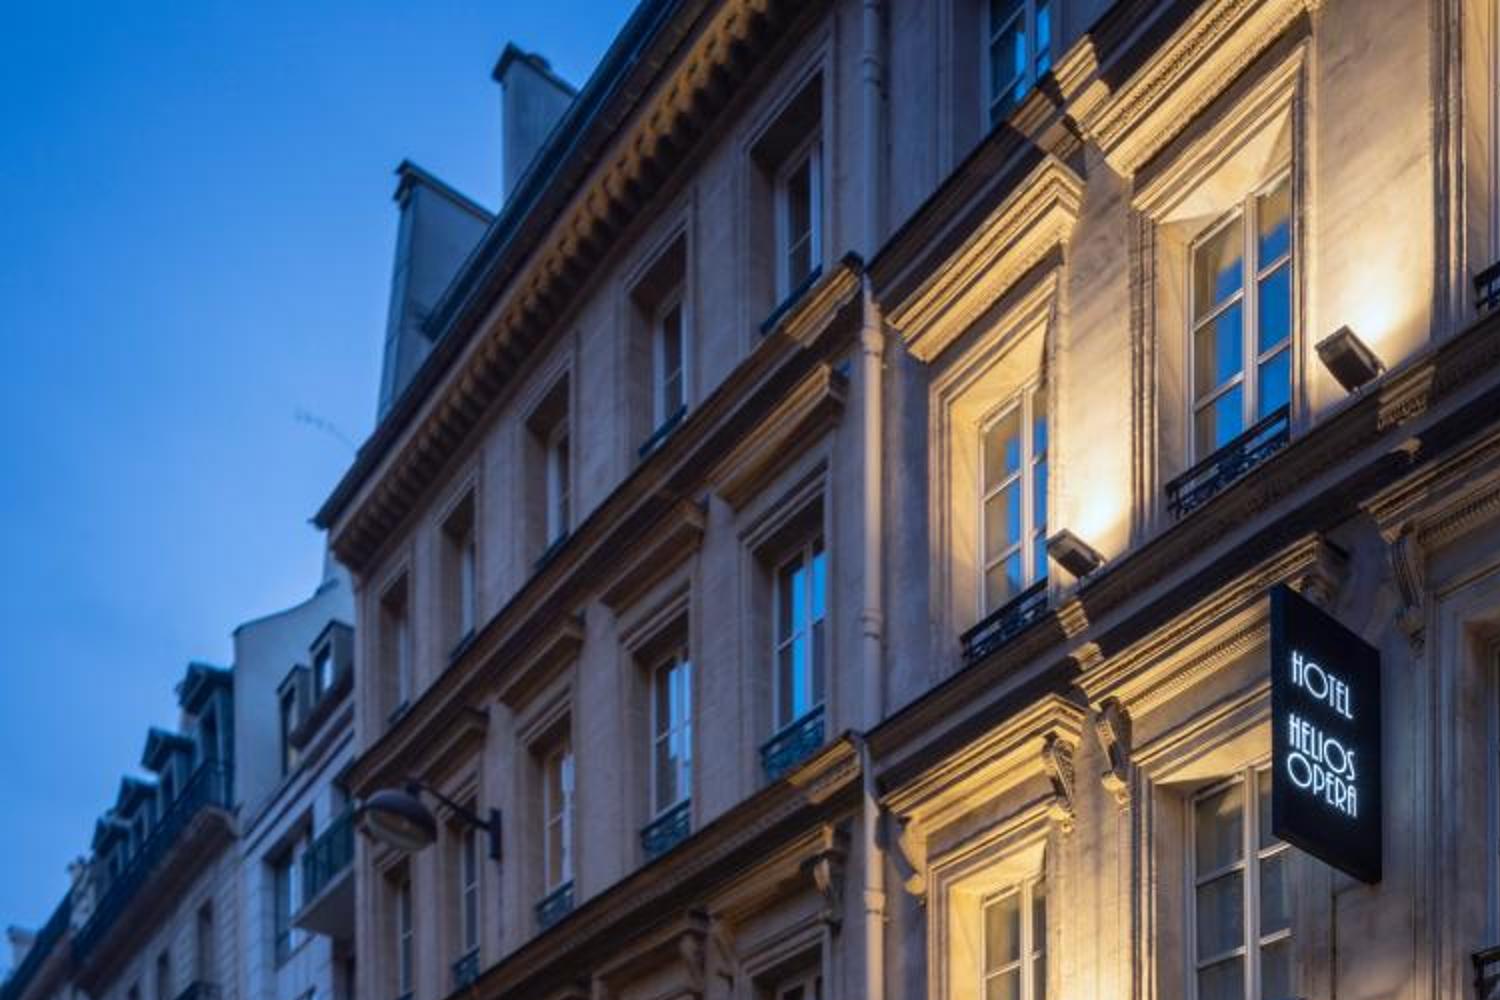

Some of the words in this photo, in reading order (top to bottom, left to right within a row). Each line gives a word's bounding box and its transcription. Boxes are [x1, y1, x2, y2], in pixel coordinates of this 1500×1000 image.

[1291, 650, 1353, 719] HOTEL
[1288, 713, 1356, 781] HELIOS
[1287, 752, 1358, 818] OPERA
